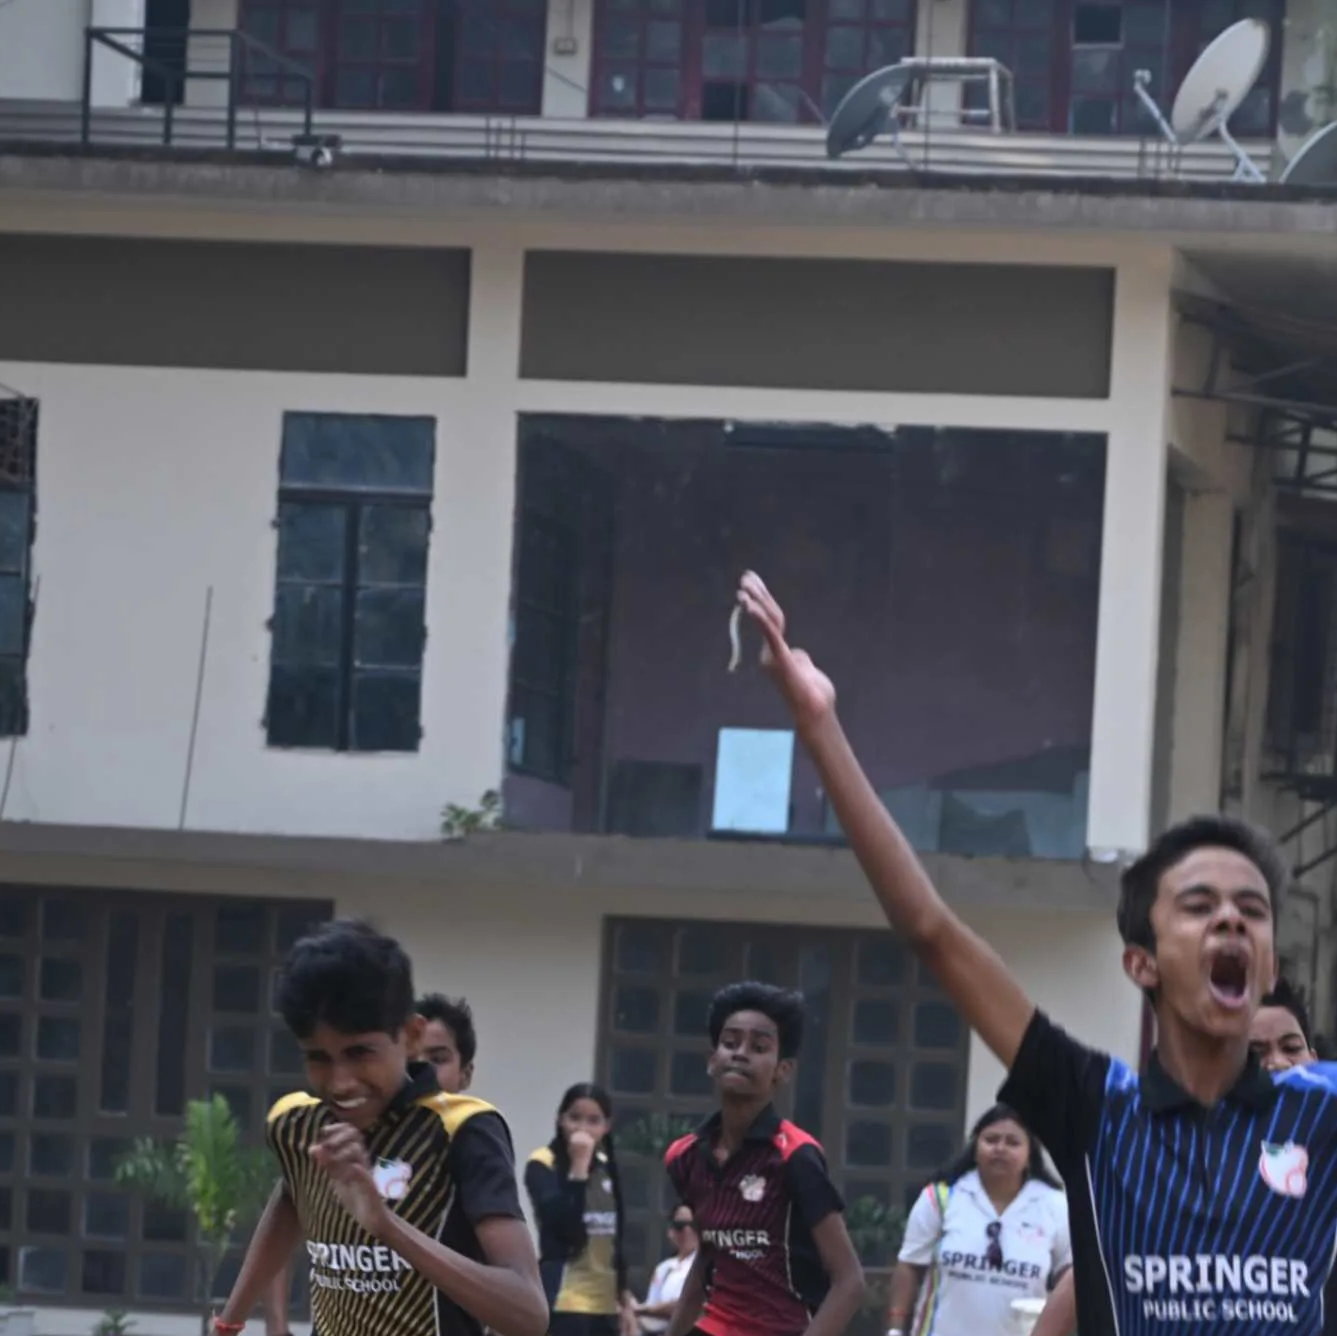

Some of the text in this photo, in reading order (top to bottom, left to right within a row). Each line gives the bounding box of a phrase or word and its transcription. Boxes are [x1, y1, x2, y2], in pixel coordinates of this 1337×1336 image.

[942, 1250, 1042, 1279] SPRIGER
[1124, 1254, 1310, 1297] SPRINGER
[1143, 1299, 1298, 1323] PUBLIC SCHOOL
